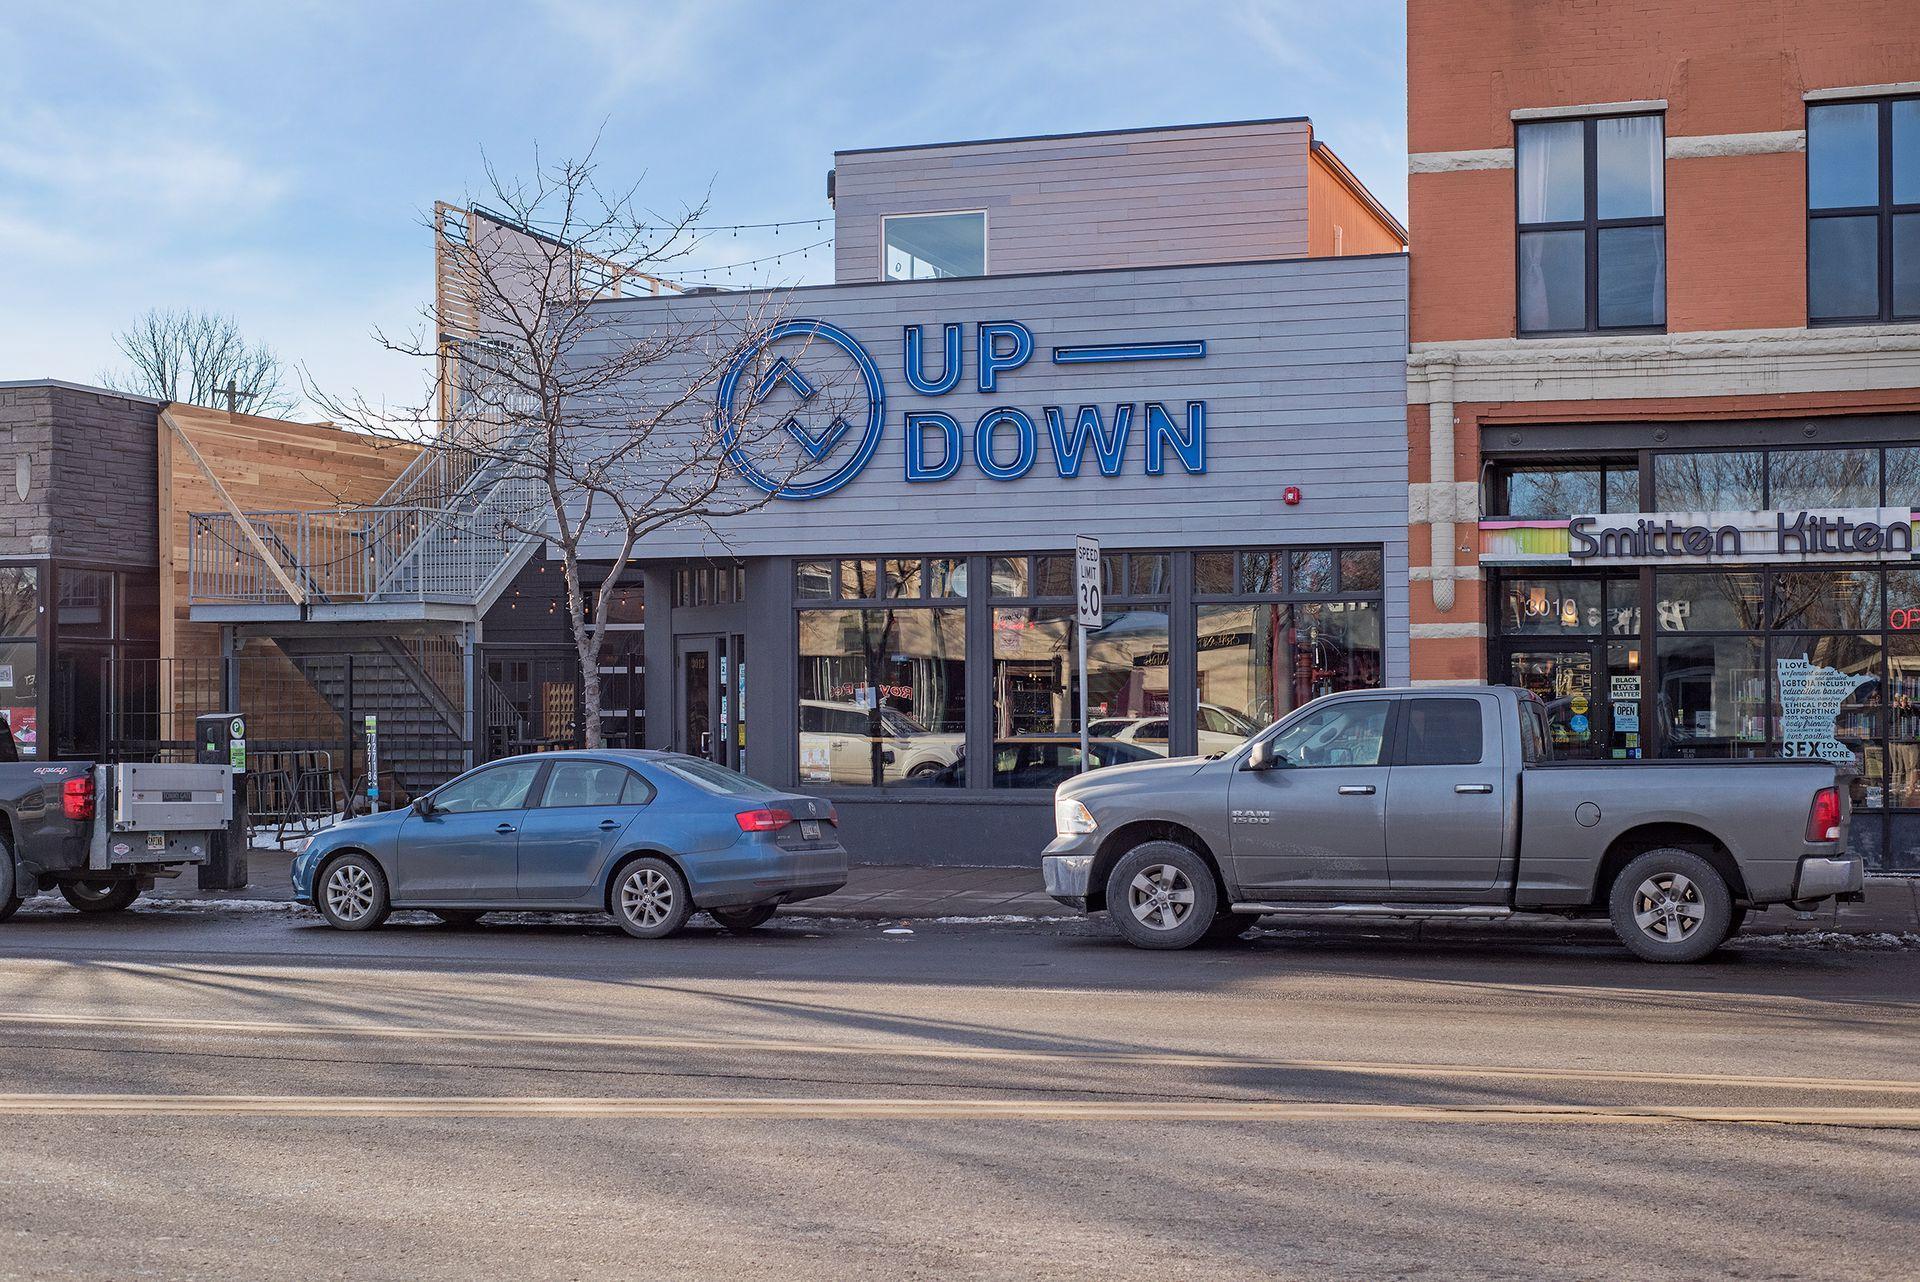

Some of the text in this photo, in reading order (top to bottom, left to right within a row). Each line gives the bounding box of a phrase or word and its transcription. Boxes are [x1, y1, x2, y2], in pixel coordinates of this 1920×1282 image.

[904, 320, 1034, 397] UP
[904, 400, 1206, 483] DOWN
[1568, 512, 1913, 558] Smitten Kitten
[1079, 546, 1098, 562] SPEED
[1081, 565, 1096, 580] LIMIT
[1081, 583, 1099, 616] 30
[1525, 599, 1576, 617] 3010
[1783, 687, 1848, 695] education based,
[1616, 705, 1636, 716] OPEN
[1786, 720, 1802, 728] body
[1784, 741, 1820, 758] SEX
